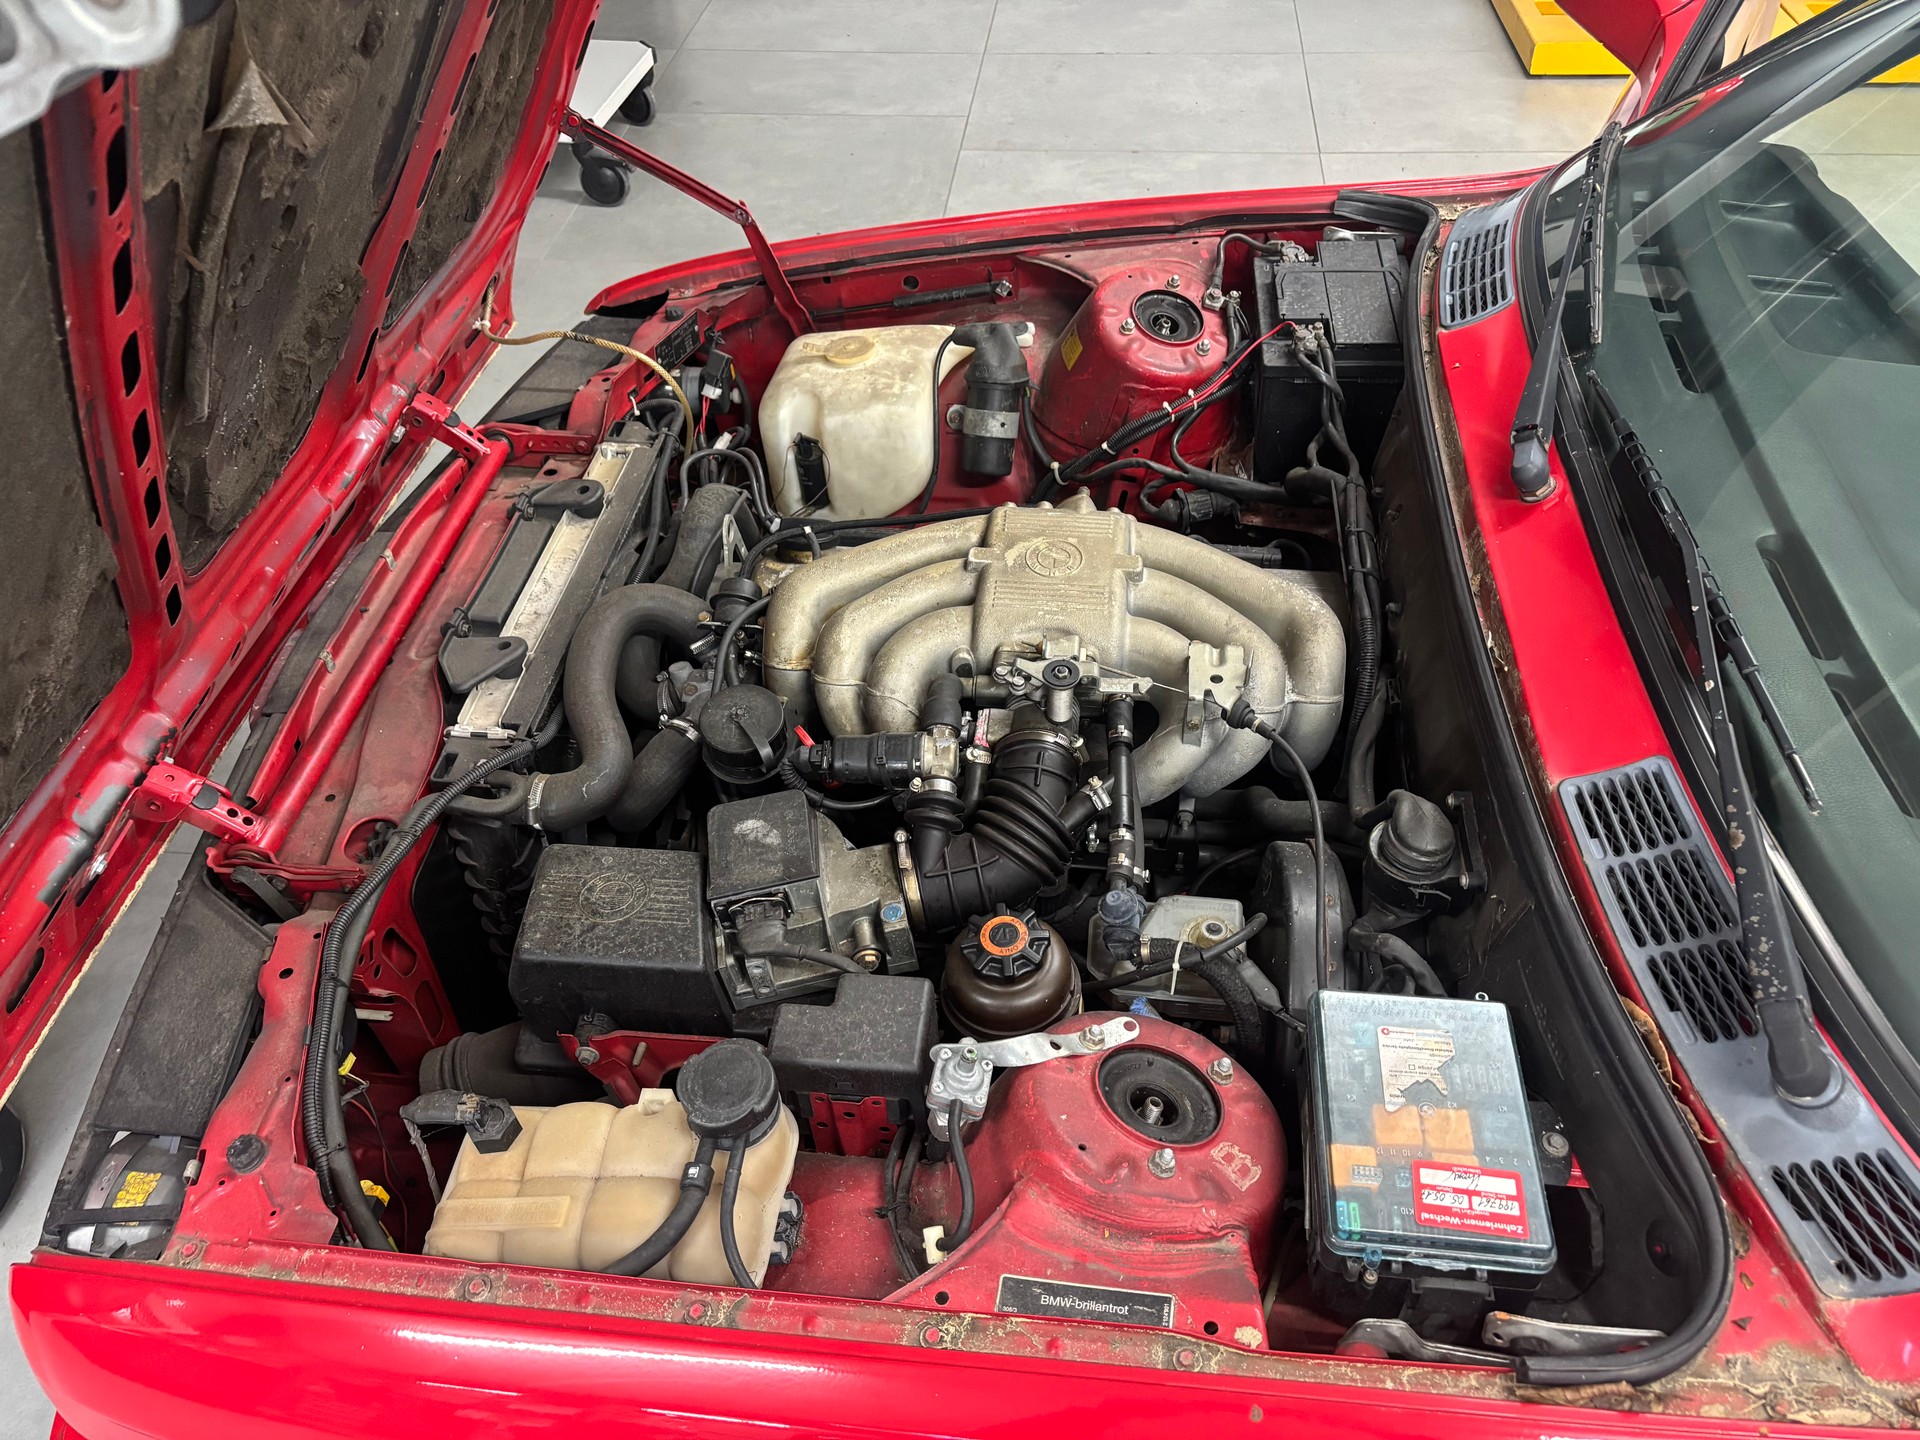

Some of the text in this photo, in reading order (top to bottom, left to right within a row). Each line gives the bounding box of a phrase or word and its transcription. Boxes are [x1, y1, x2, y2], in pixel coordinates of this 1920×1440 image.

[999, 945, 1019, 954] ONLY
[1447, 1101, 1458, 1109] K2
[1498, 1105, 1508, 1113] K1
[1376, 1147, 1384, 1155] 12
[1402, 1148, 1411, 1156] 10
[1436, 1185, 1453, 1193] Datum
[1478, 1198, 1516, 1212] 199761
[1400, 1206, 1415, 1216] K10
[1420, 1211, 1524, 1234] Zahnriemen-Wechsel
[1040, 1294, 1129, 1315] BMW-brillantrot
